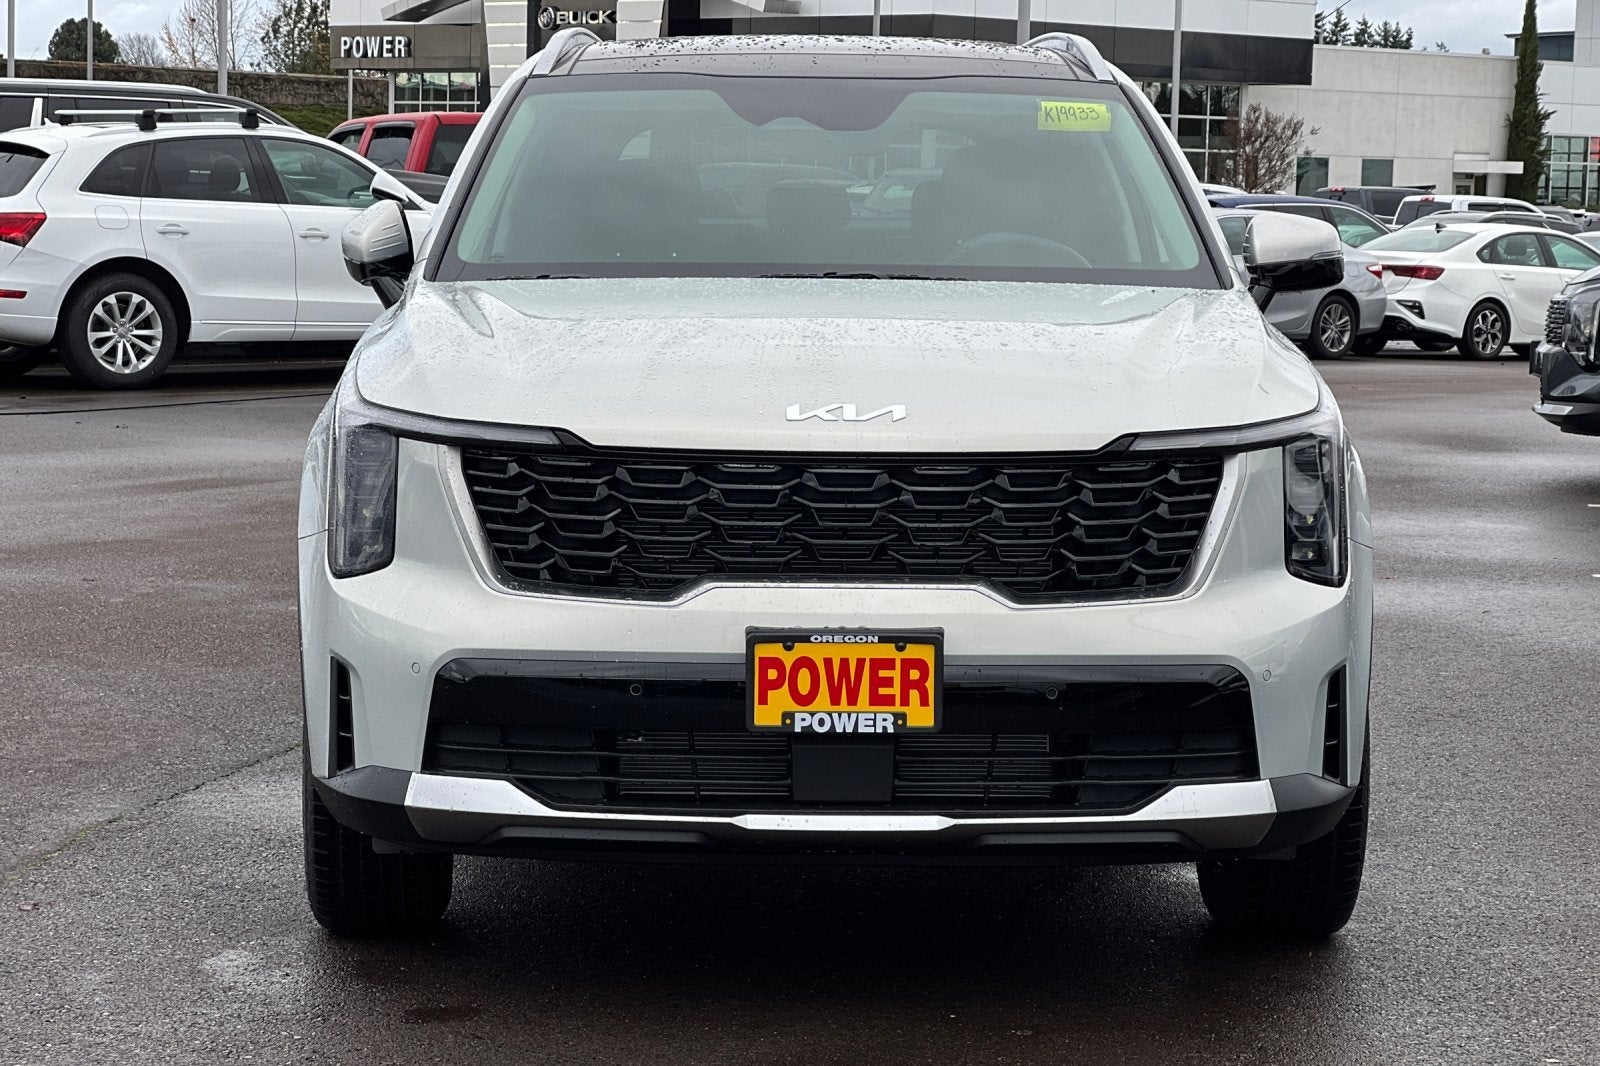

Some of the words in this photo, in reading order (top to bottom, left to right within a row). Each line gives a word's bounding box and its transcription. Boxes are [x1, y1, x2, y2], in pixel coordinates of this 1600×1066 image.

[556, 10, 612, 24] BUICK
[340, 36, 406, 58] POWER
[1044, 105, 1100, 123] K19933
[810, 635, 879, 643] OREGON
[757, 656, 930, 707] POWER
[794, 712, 894, 733] POWER
